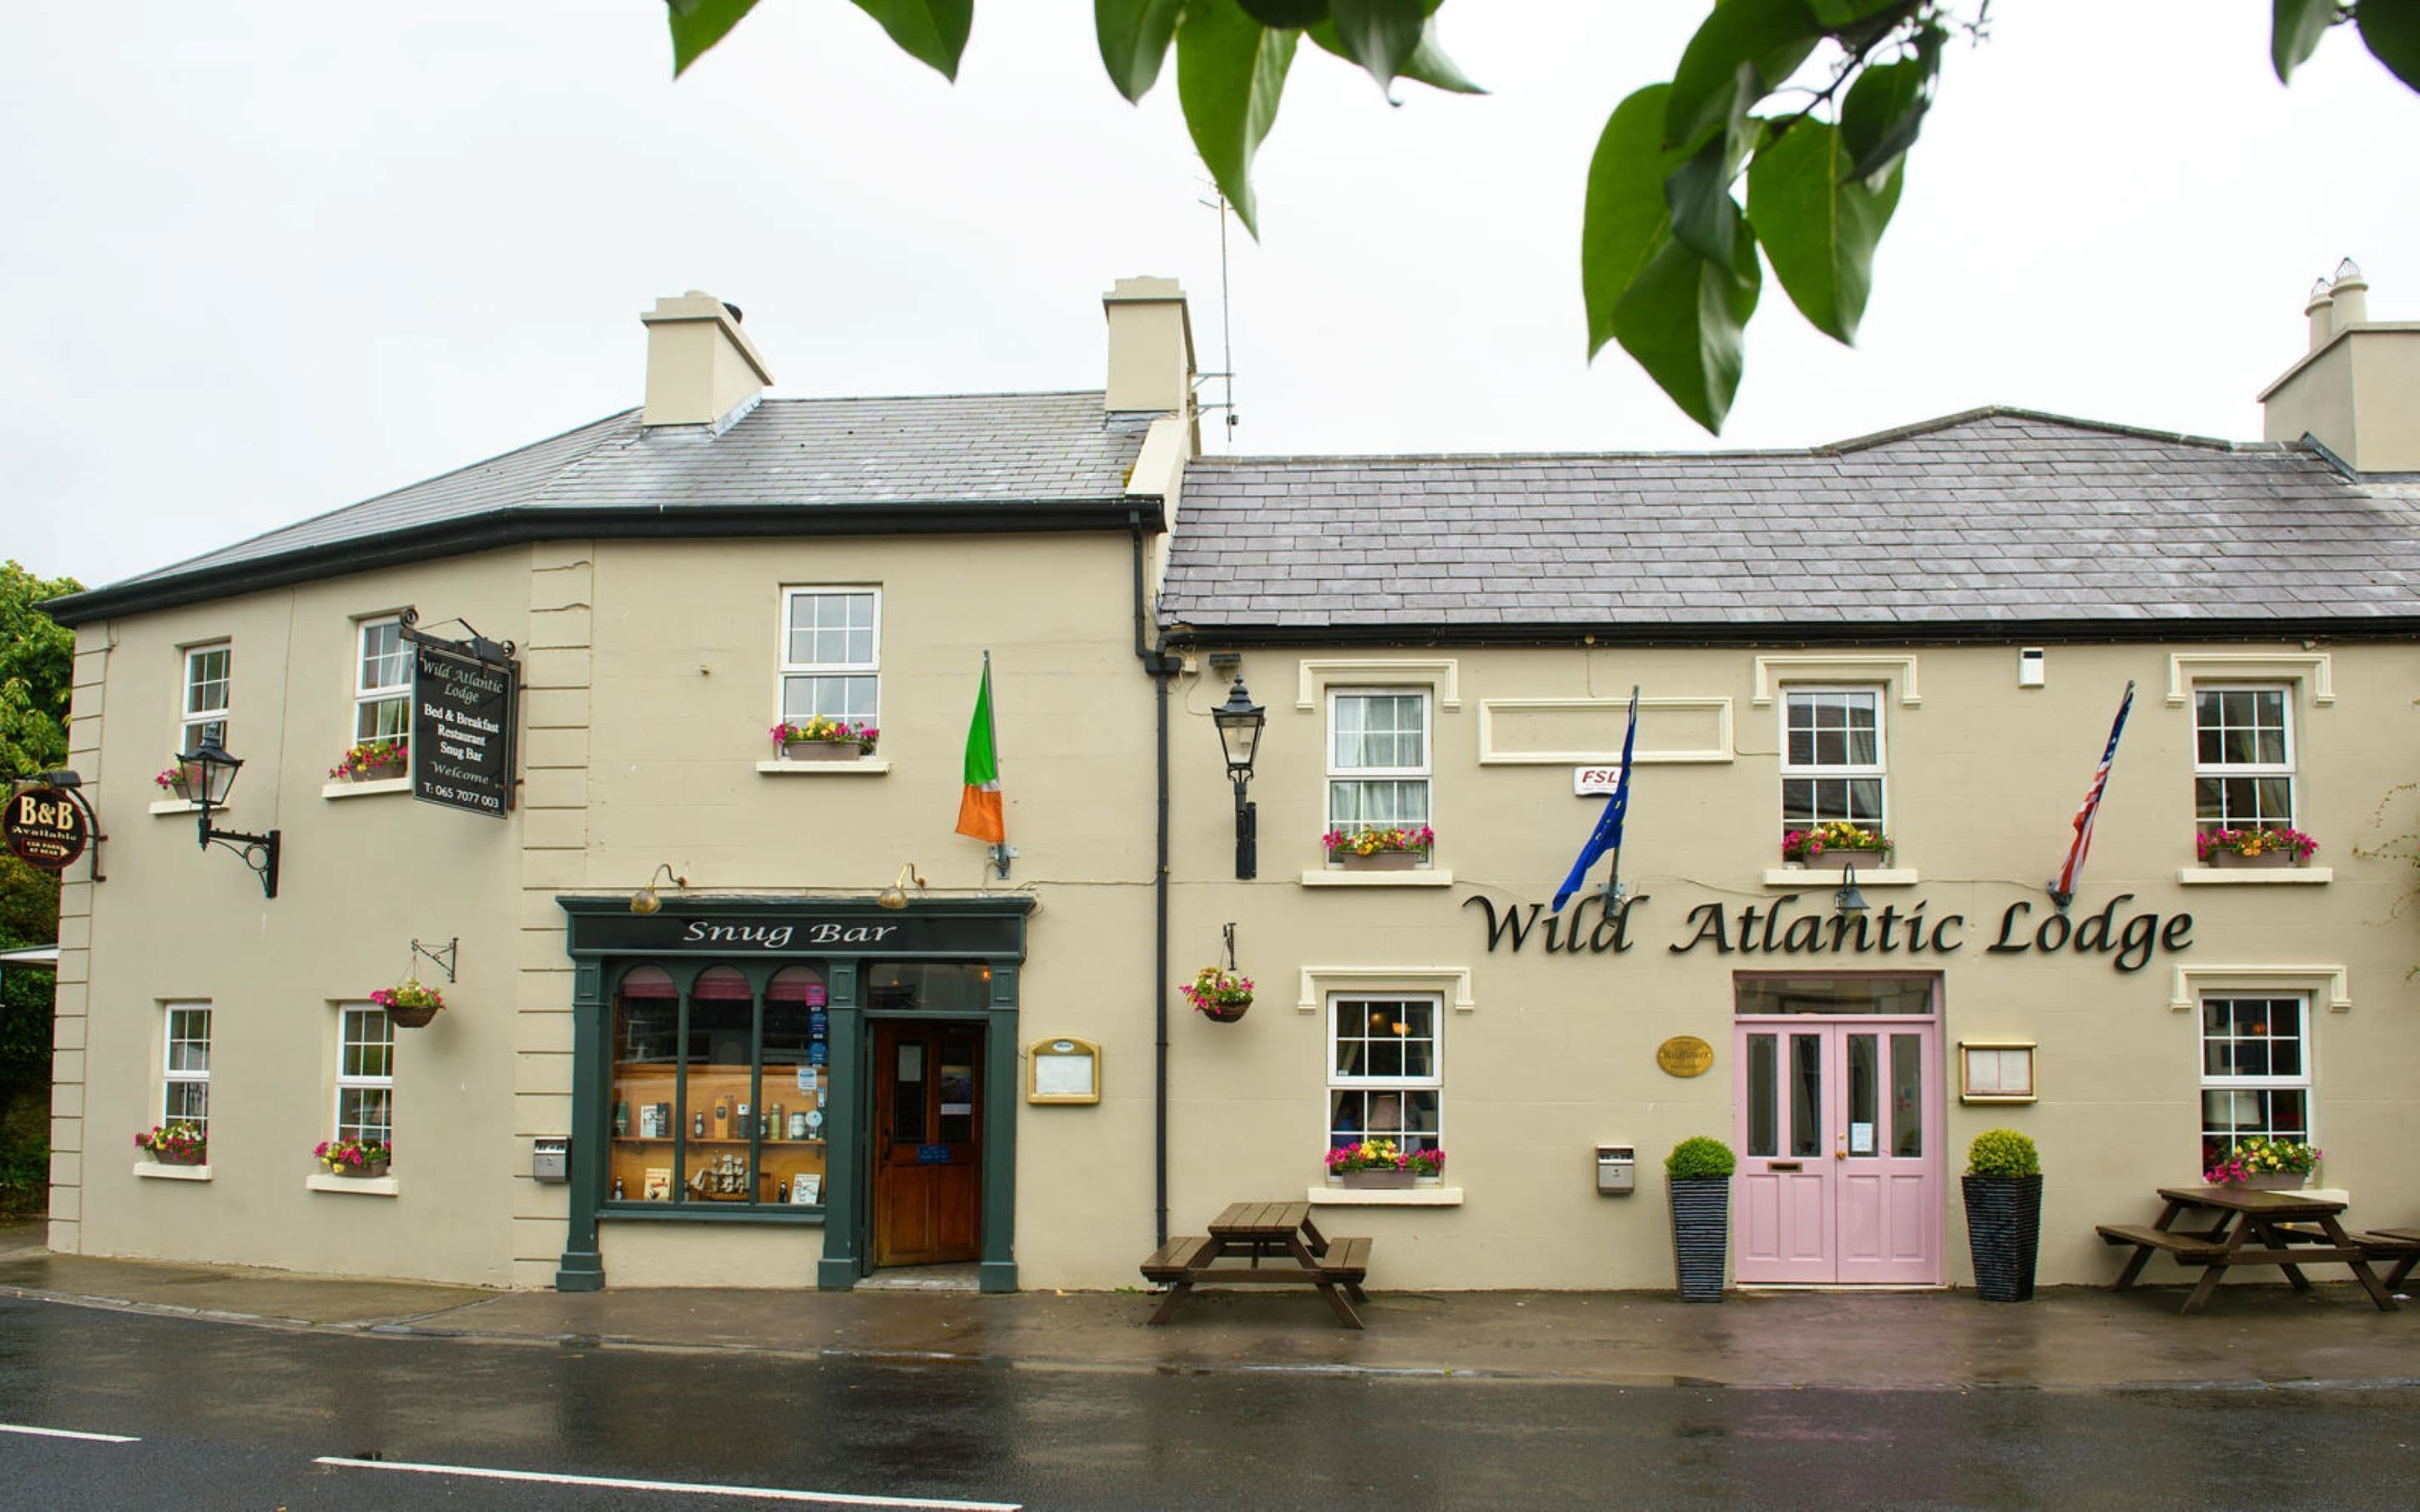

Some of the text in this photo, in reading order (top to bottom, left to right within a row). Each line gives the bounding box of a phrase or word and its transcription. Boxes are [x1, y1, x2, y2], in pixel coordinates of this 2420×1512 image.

[420, 658, 504, 694] Wild Atlantic
[444, 683, 480, 704] Lodge
[424, 703, 500, 734] Bed & Breakfast
[437, 723, 487, 748] Restaurant
[440, 741, 484, 763] Snug Bar
[431, 761, 489, 784] Welcome
[1582, 770, 1617, 783] FSL
[424, 782, 500, 809] T: 065 7077 003
[19, 796, 73, 830] B&B
[12, 826, 77, 841] Available
[683, 921, 898, 949] Snug Bar
[1462, 893, 2194, 972] Wild Atlantic Lodge
